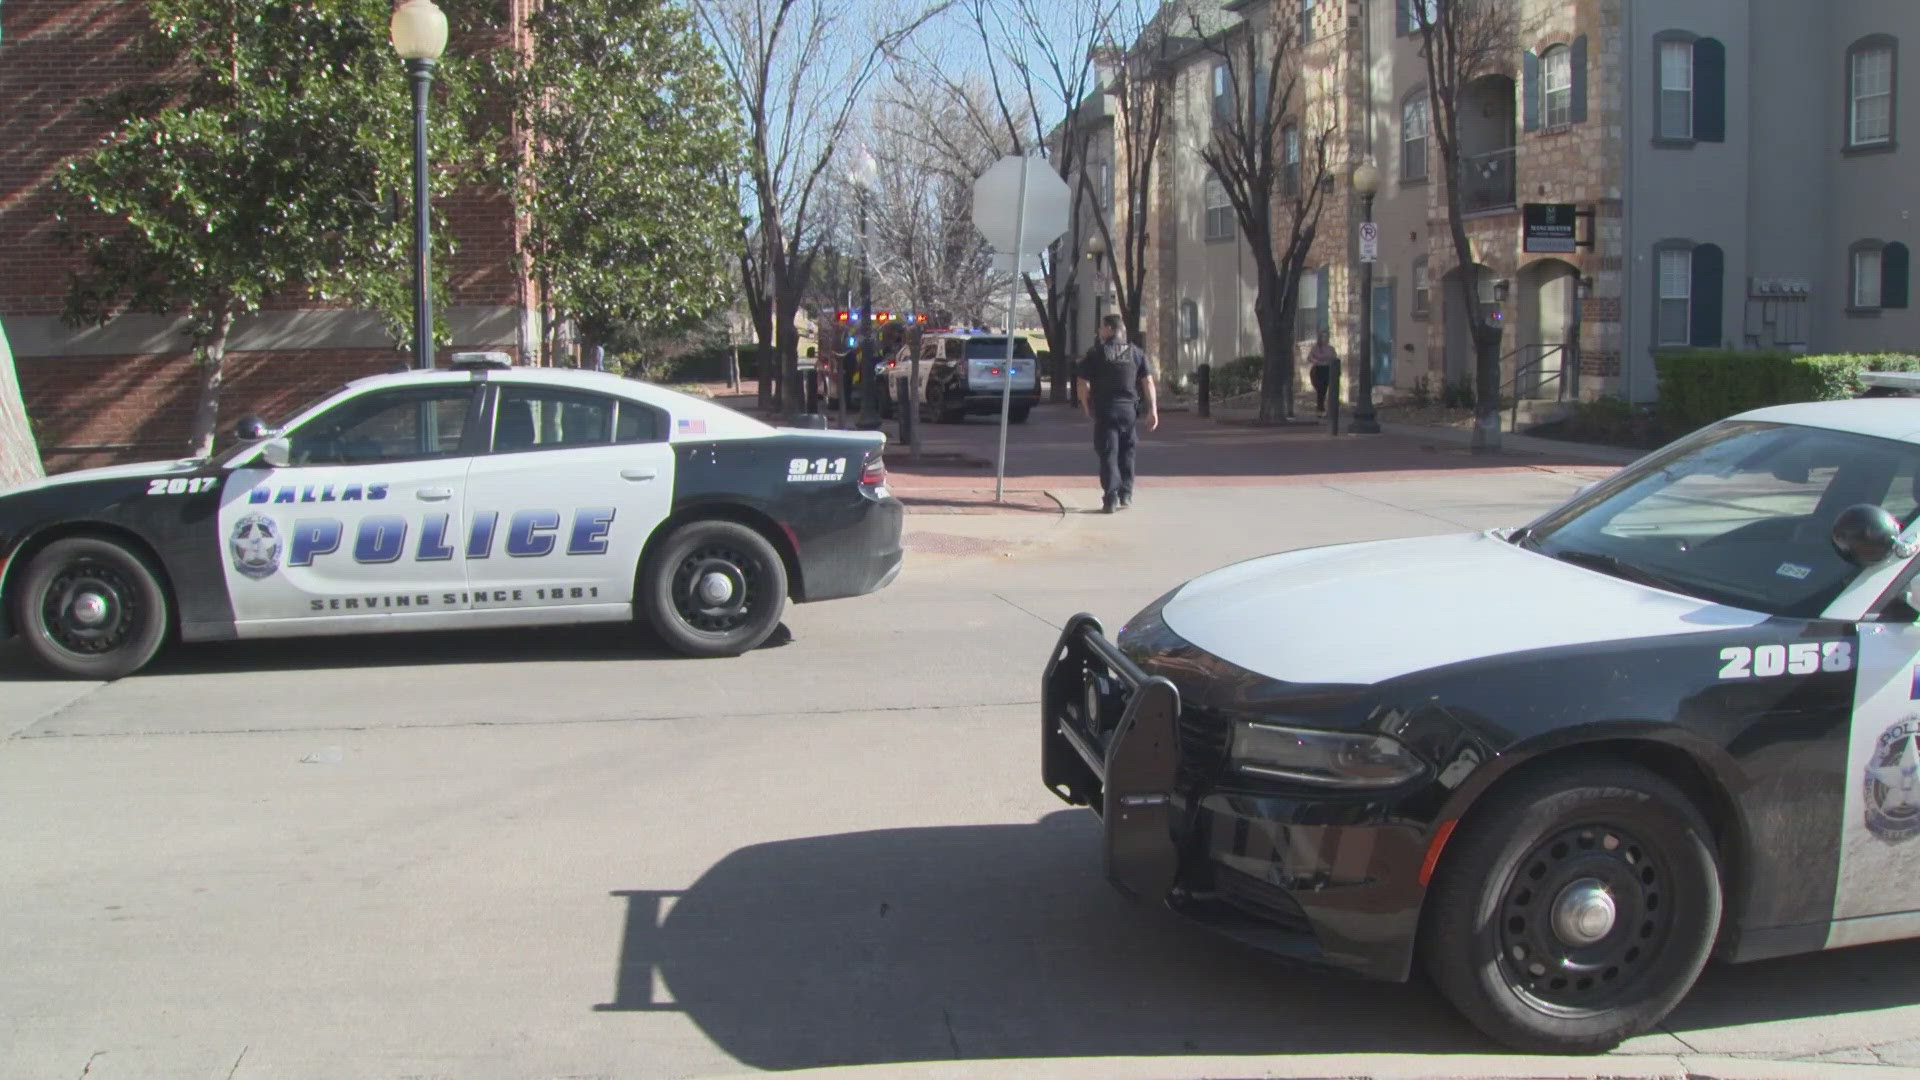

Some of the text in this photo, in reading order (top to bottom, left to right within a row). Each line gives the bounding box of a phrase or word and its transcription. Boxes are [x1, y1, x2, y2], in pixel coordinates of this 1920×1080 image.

[147, 477, 218, 495] 2017
[787, 474, 843, 482] EMERGENCY
[248, 482, 389, 504] DALLAS
[287, 506, 617, 567] POLICE
[310, 586, 599, 611] SERVING SINCE 1881
[1718, 641, 1851, 678] 2058
[1879, 722, 1920, 747] POL
